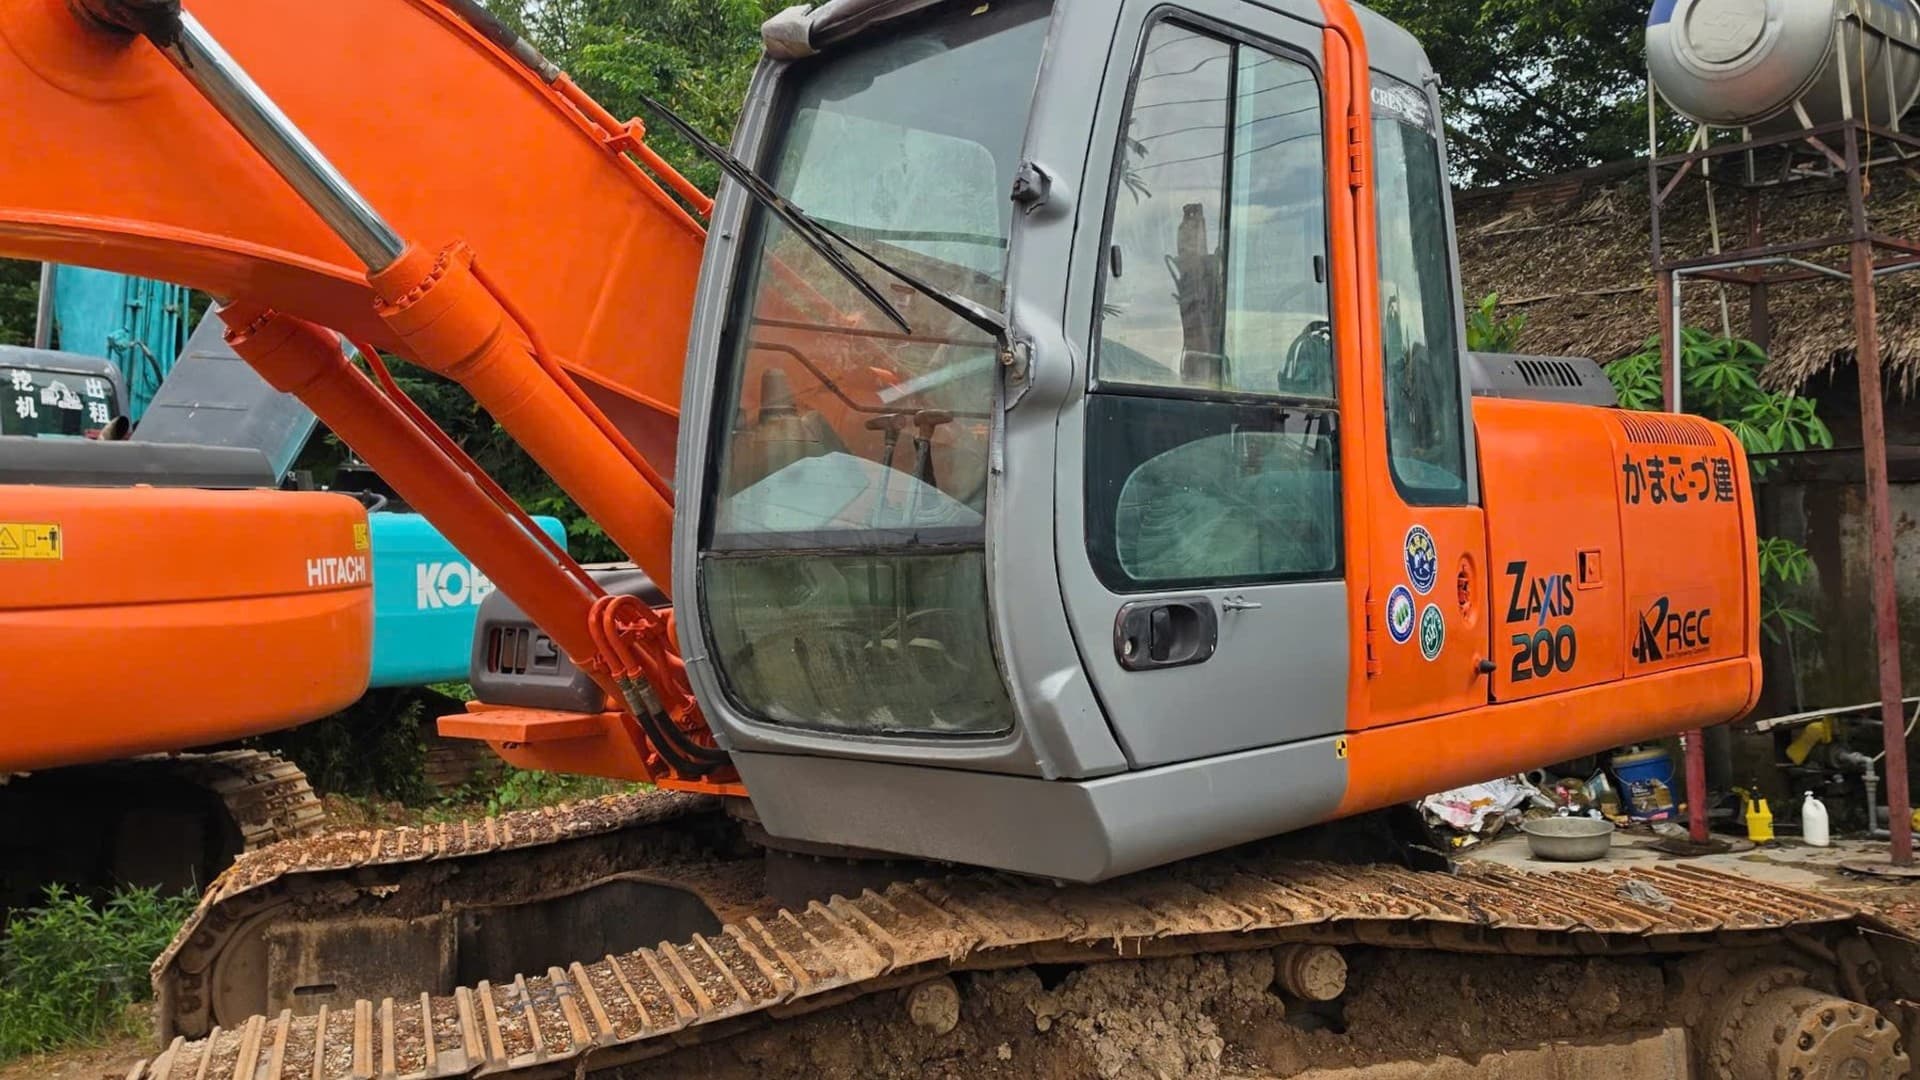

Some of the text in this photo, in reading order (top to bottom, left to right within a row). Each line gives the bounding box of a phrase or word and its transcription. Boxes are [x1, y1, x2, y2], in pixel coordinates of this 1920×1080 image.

[11, 369, 38, 418] 挖机
[86, 378, 110, 423] 出租
[307, 556, 366, 587] HITACHI
[1666, 608, 1711, 652] REC
[1511, 624, 1576, 682] 200
